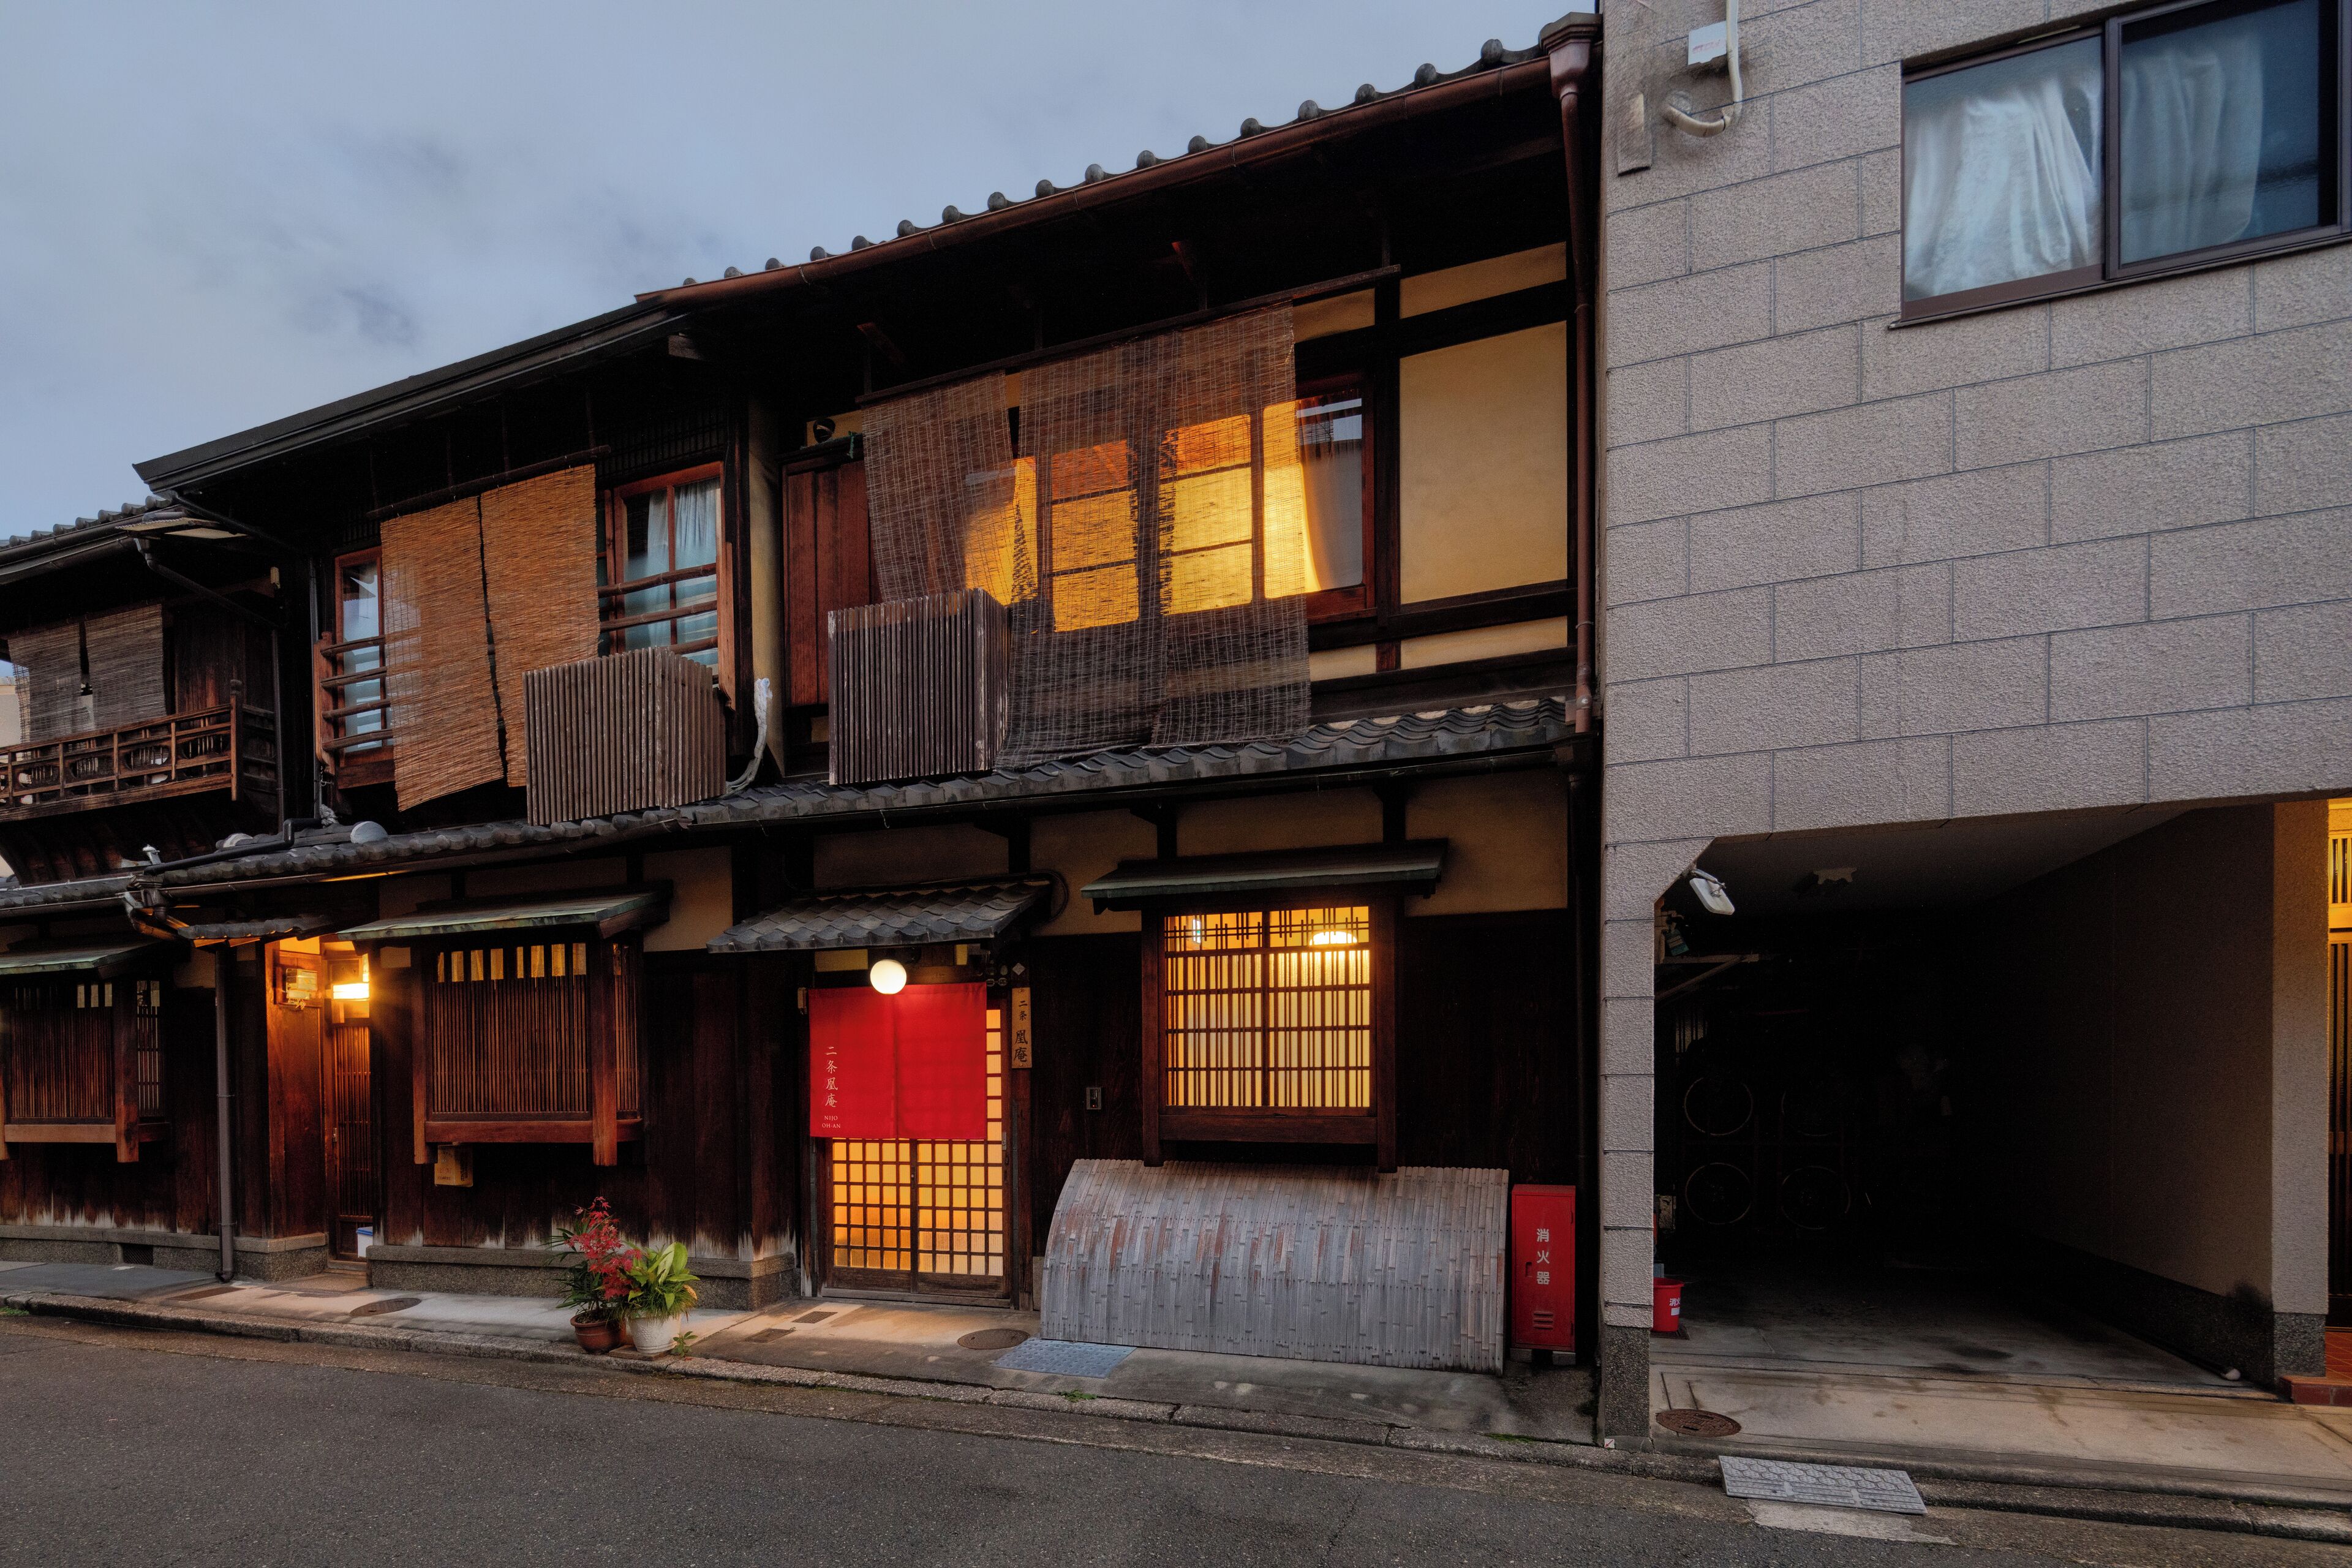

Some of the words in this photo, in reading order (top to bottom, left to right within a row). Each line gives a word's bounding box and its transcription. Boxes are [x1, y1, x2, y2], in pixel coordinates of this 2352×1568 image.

[825, 1046, 838, 1108] 二条凰庵
[1536, 1228, 1550, 1284] 消火器
